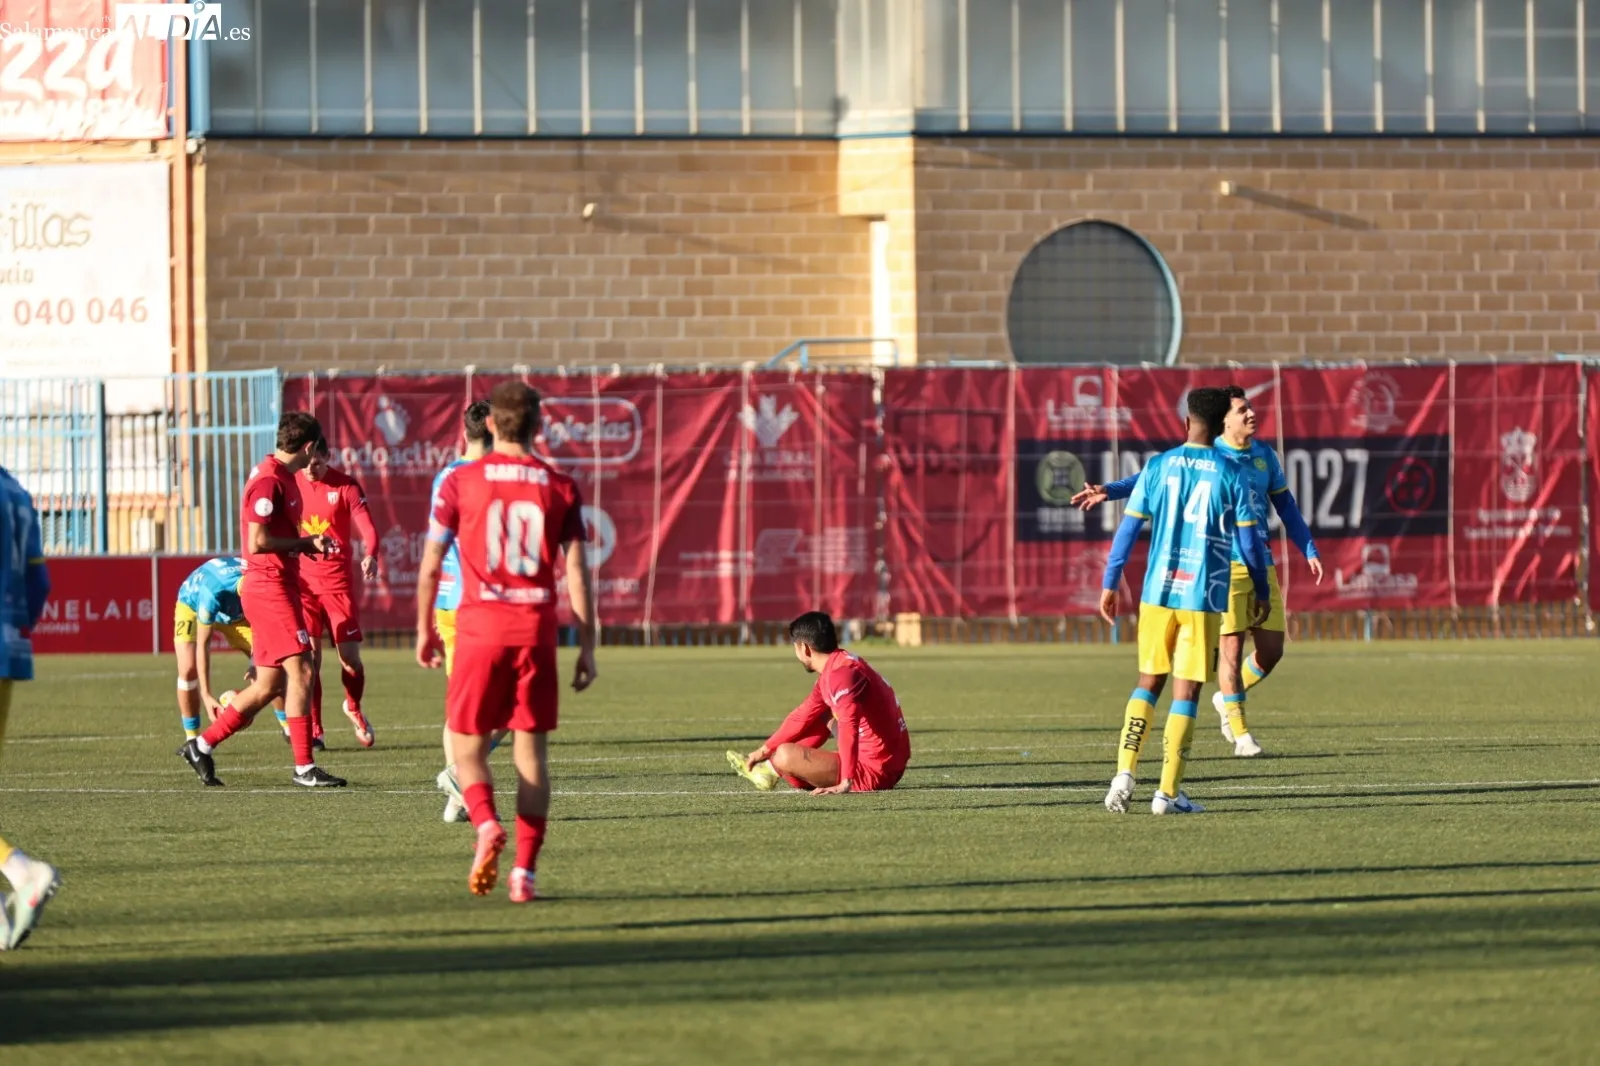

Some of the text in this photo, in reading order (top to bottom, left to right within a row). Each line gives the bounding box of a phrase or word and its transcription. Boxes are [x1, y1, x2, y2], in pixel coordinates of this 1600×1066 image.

[13, 296, 149, 326] 040 046
[1168, 455, 1219, 473] FAYSEL
[1166, 475, 1213, 535] 14
[486, 498, 546, 577] 10
[176, 620, 193, 637] 21
[1123, 716, 1149, 753] DIOCES
